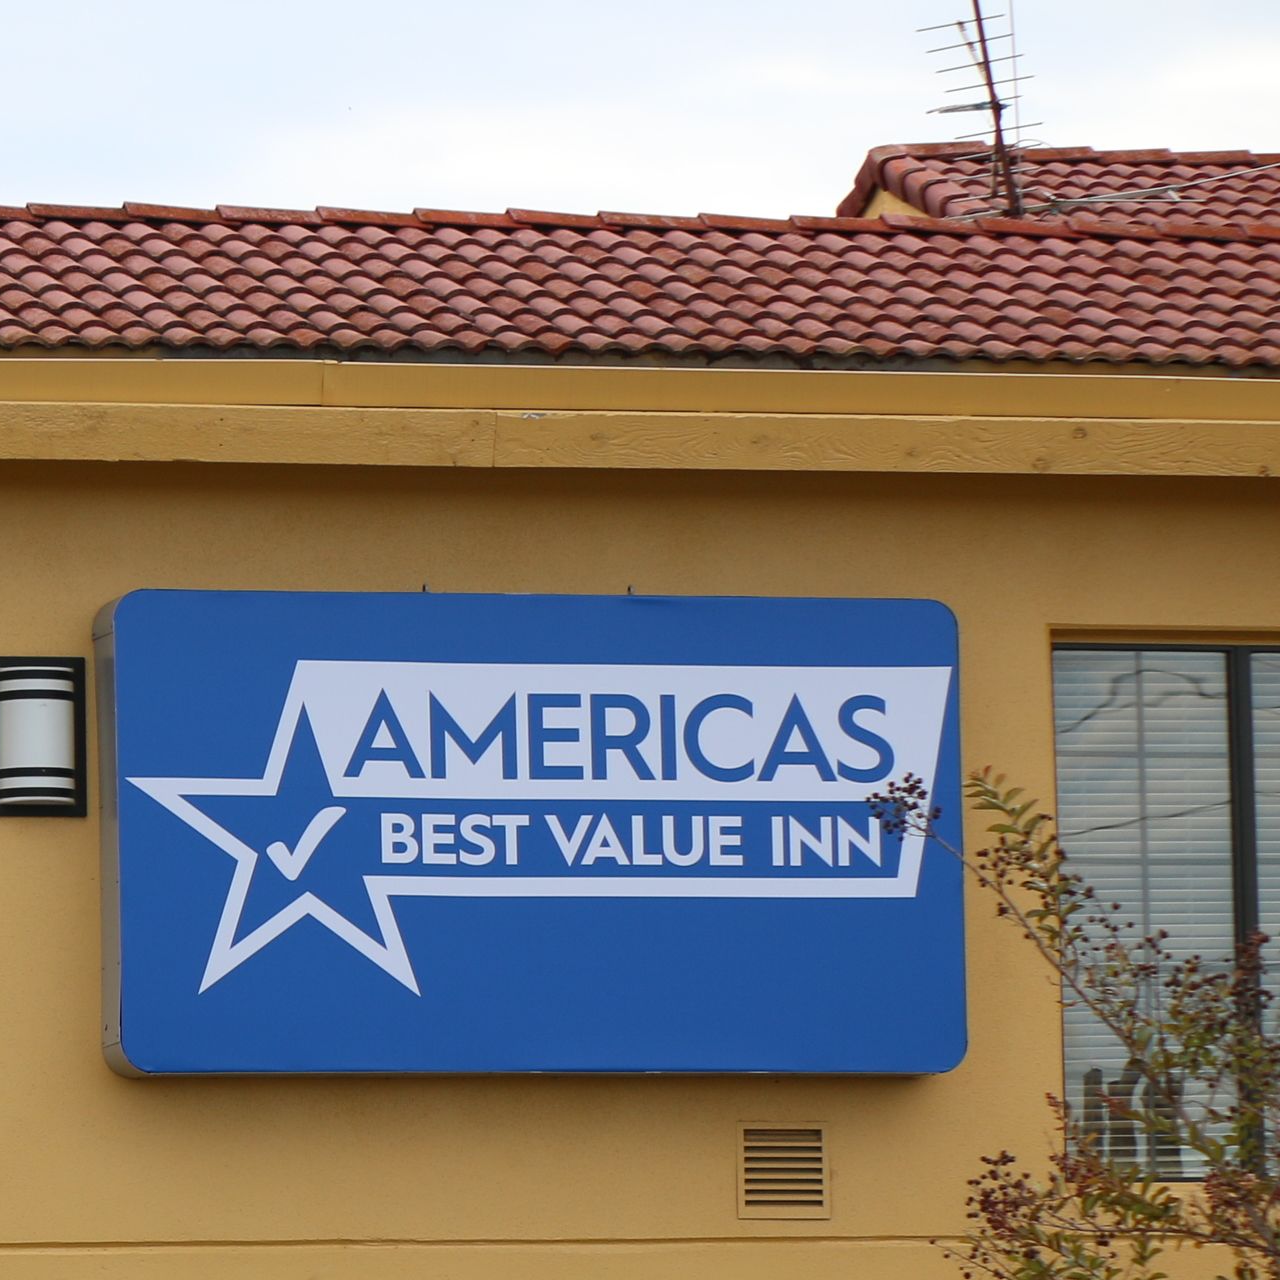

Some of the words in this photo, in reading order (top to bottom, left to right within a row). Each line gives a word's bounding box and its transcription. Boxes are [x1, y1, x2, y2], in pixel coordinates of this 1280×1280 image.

[342, 687, 895, 783] AMERICAS
[380, 812, 530, 866] BEST
[544, 814, 744, 867] VALUE
[771, 815, 882, 868] INN
